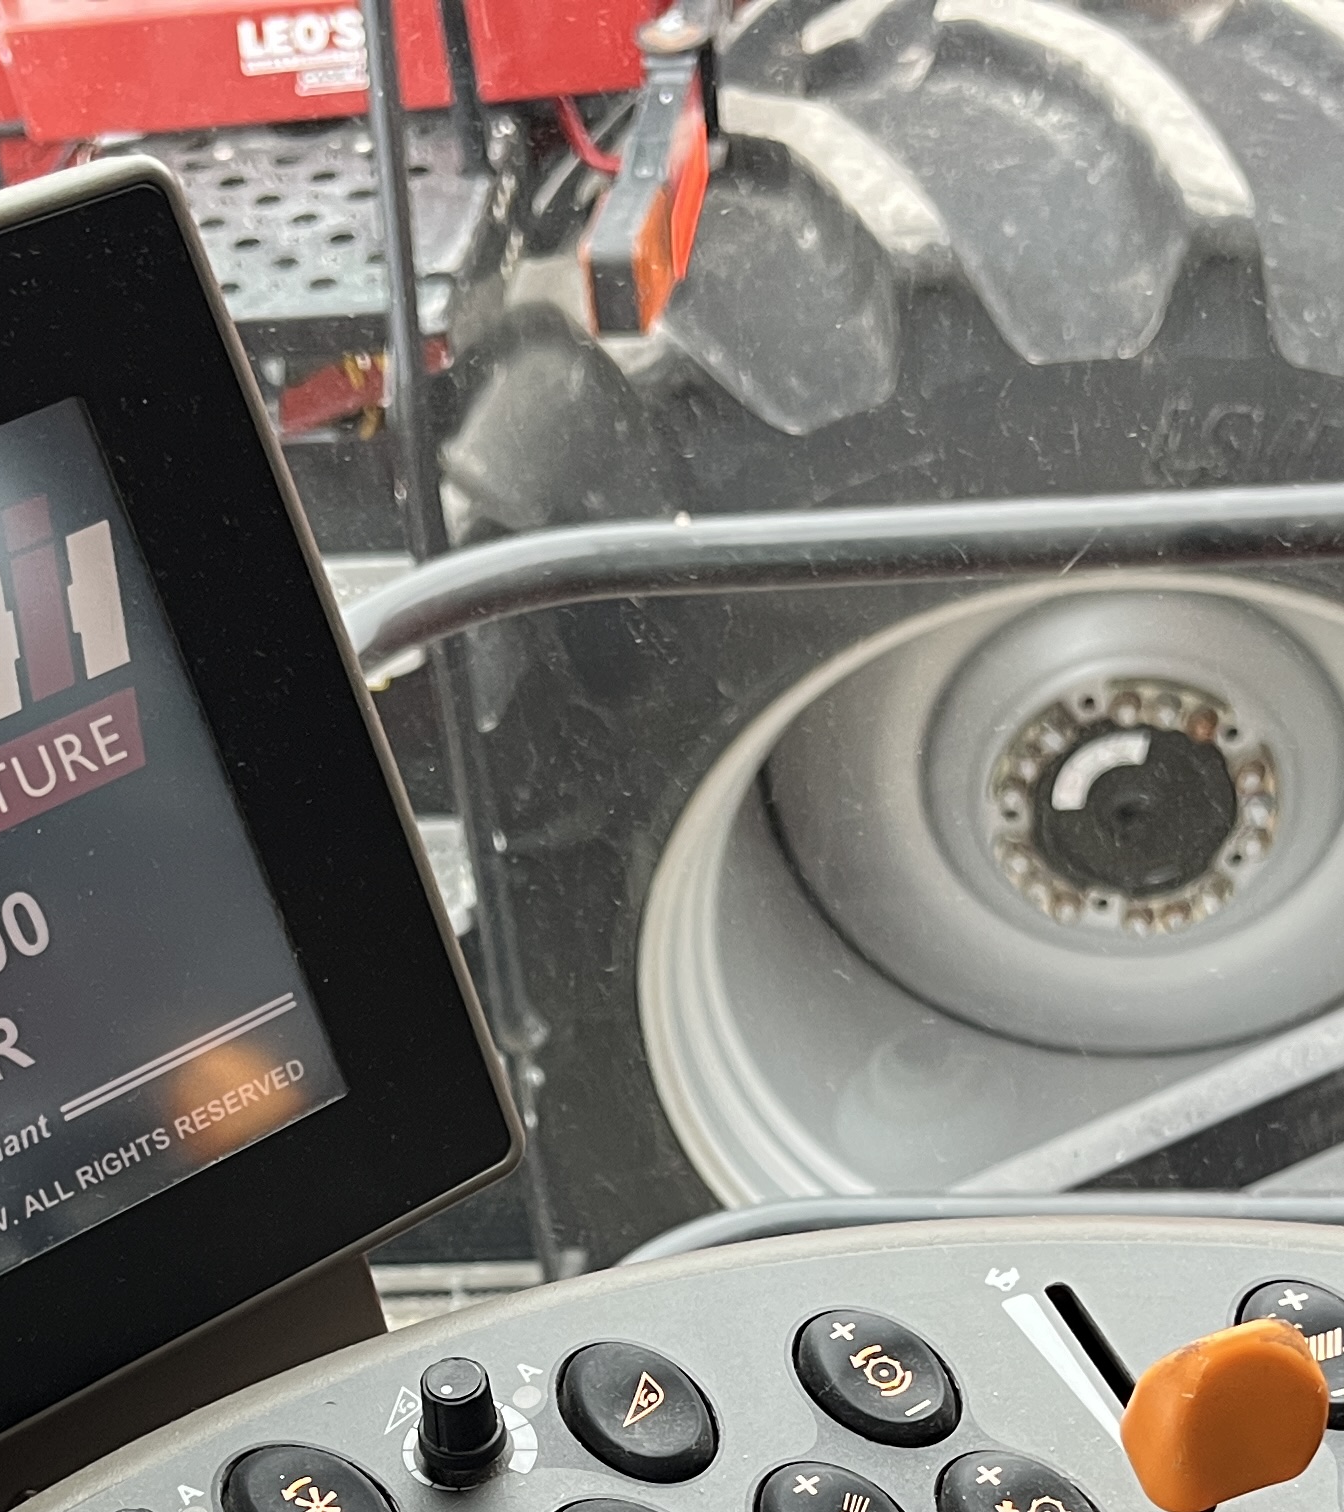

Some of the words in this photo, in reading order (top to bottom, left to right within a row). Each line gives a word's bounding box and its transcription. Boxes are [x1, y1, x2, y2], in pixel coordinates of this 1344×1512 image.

[237, 7, 366, 59] LEO'S
[24, 1180, 75, 1219] ALL
[75, 1126, 171, 1190] RIGHTS
[174, 1059, 306, 1140] RESERVED
[517, 1363, 544, 1383] A
[177, 1484, 205, 1506] A
